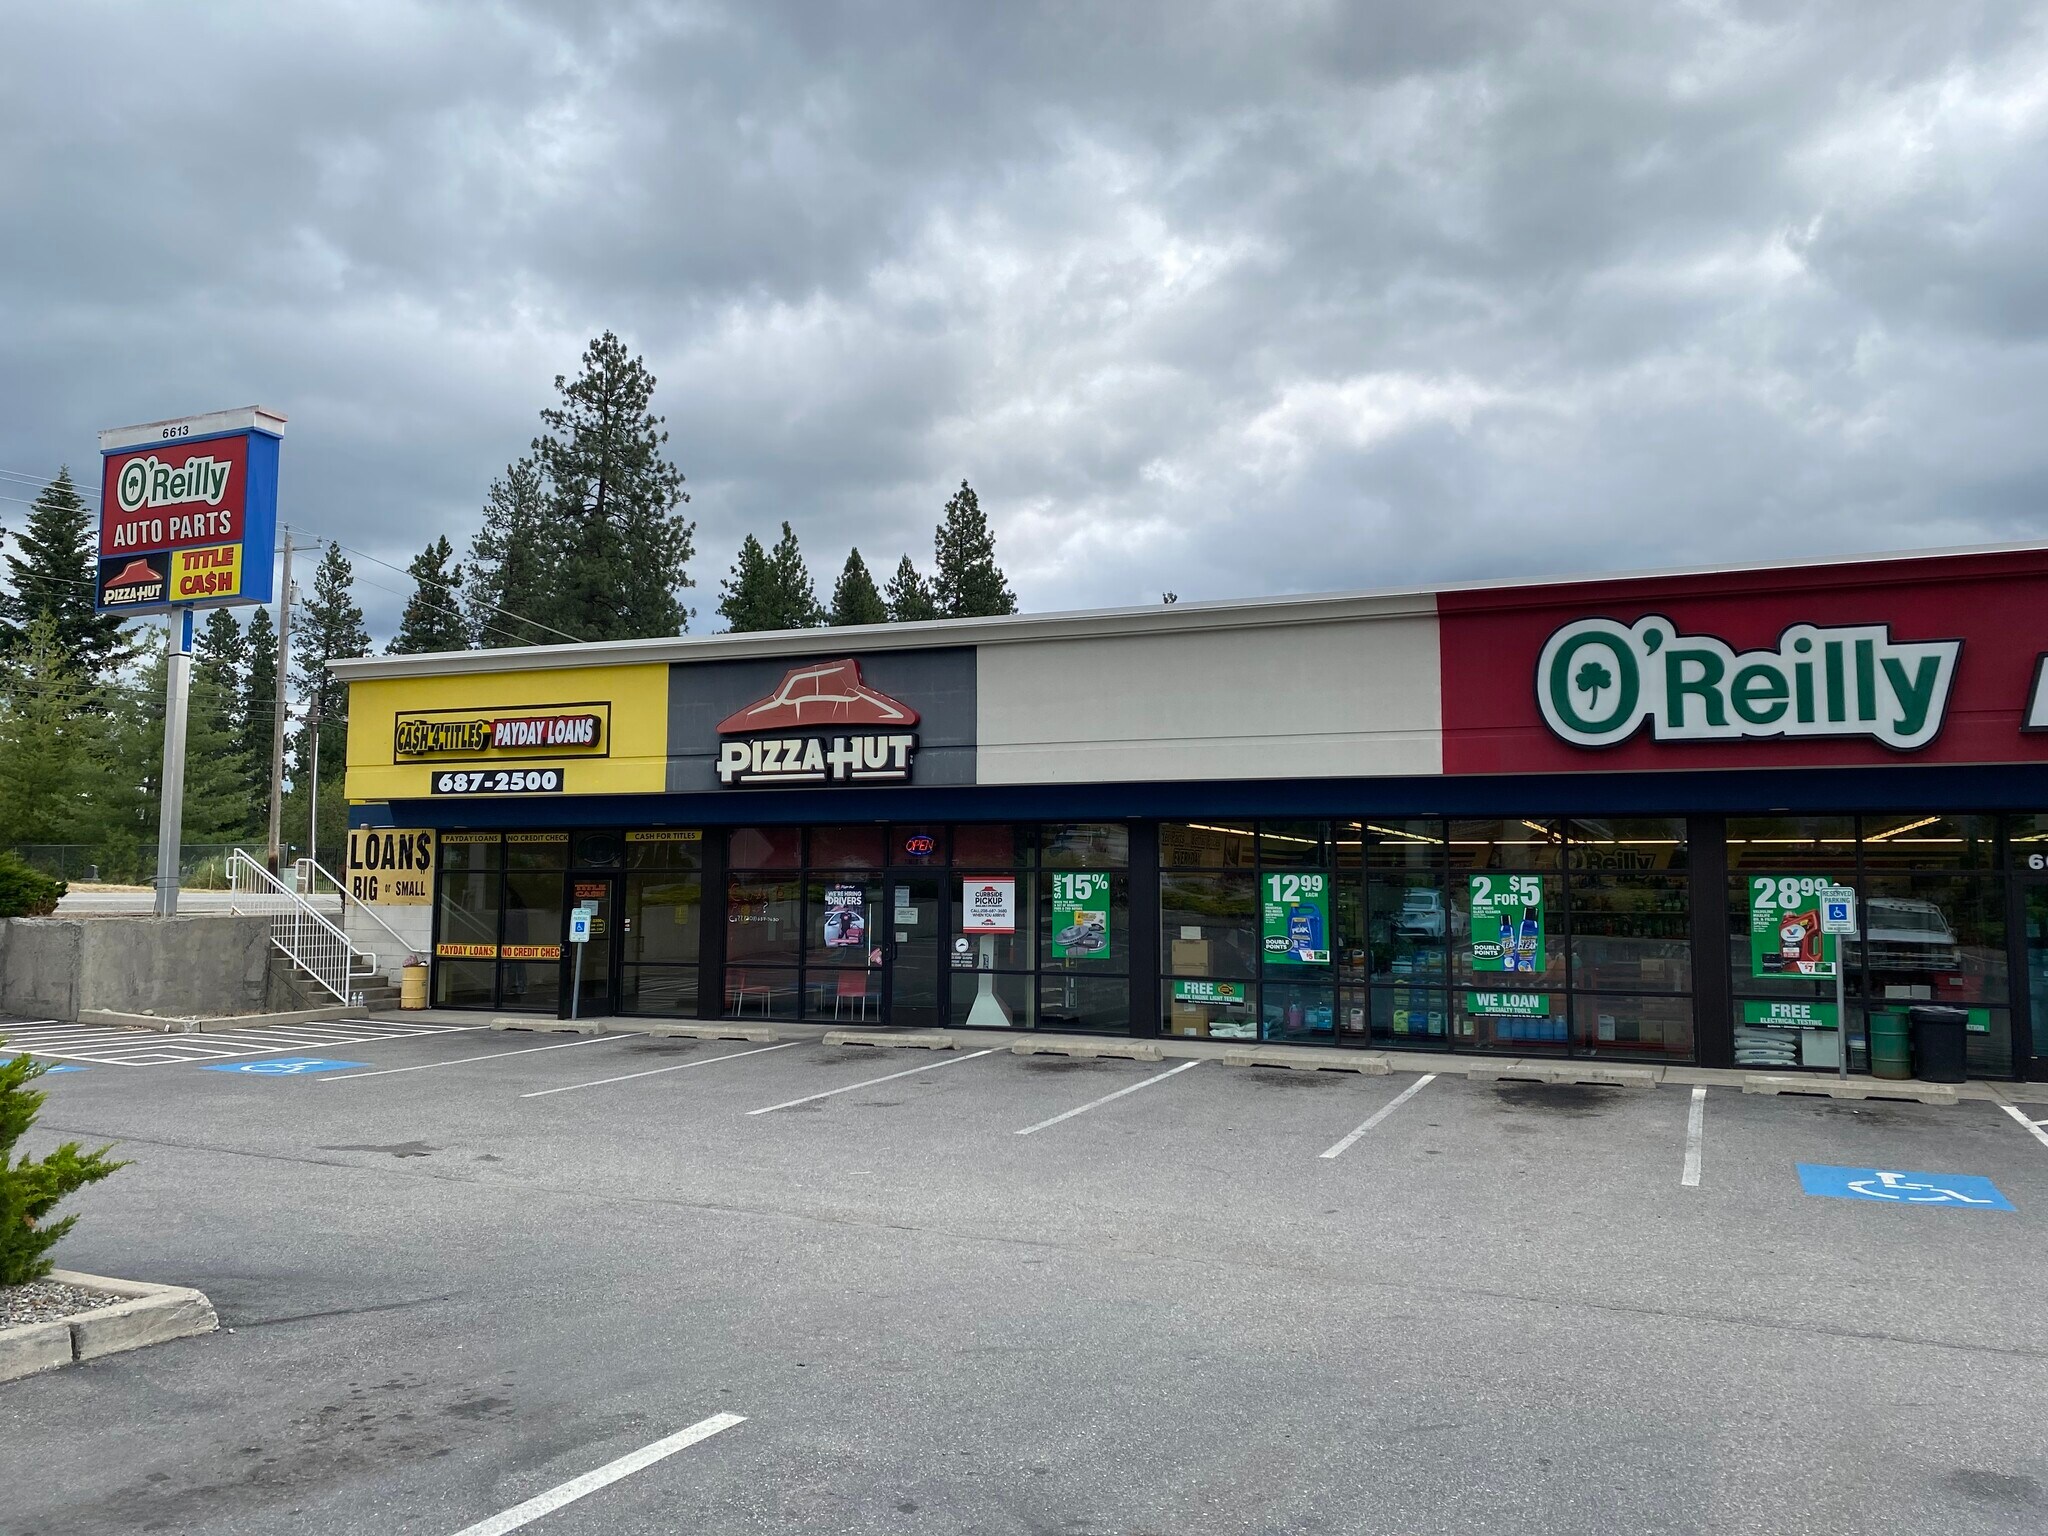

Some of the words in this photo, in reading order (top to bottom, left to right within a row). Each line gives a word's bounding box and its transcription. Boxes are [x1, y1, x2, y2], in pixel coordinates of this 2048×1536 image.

[162, 426, 189, 438] 6613
[120, 457, 229, 509] O'Reilly
[113, 518, 162, 547] AUTO
[170, 510, 231, 540] PARTS
[182, 547, 234, 571] TITLE
[104, 586, 136, 604] PIZZA
[136, 584, 162, 602] HUT
[180, 571, 232, 595] CA$H
[1549, 627, 1942, 736] O'Reilly
[396, 722, 429, 754] CA$H
[430, 724, 443, 750] 4
[443, 720, 484, 750] TITLES
[494, 720, 545, 746] PAYDAY
[547, 718, 594, 744] LOANS
[716, 738, 825, 782] PIZZA
[826, 734, 913, 778] HUT
[438, 771, 558, 793] 687-2500
[906, 840, 934, 850] OPEN
[2028, 854, 2048, 870] 6
[354, 876, 378, 900] BIG
[385, 884, 391, 894] or
[395, 881, 426, 896] SMALL
[1062, 874, 1108, 900] 15%
[1472, 876, 1492, 905] 2
[1494, 894, 1519, 905] FOR
[1509, 875, 1540, 906] $5
[828, 897, 862, 905] DRIVERS
[440, 945, 467, 955] PAYDAY
[502, 946, 512, 956] NO
[514, 947, 540, 957] CREDIT
[1184, 981, 1213, 995] FREE
[1476, 993, 1498, 1006] WE
[1502, 994, 1539, 1007] LOAN
[1771, 1004, 1811, 1018] FREE
